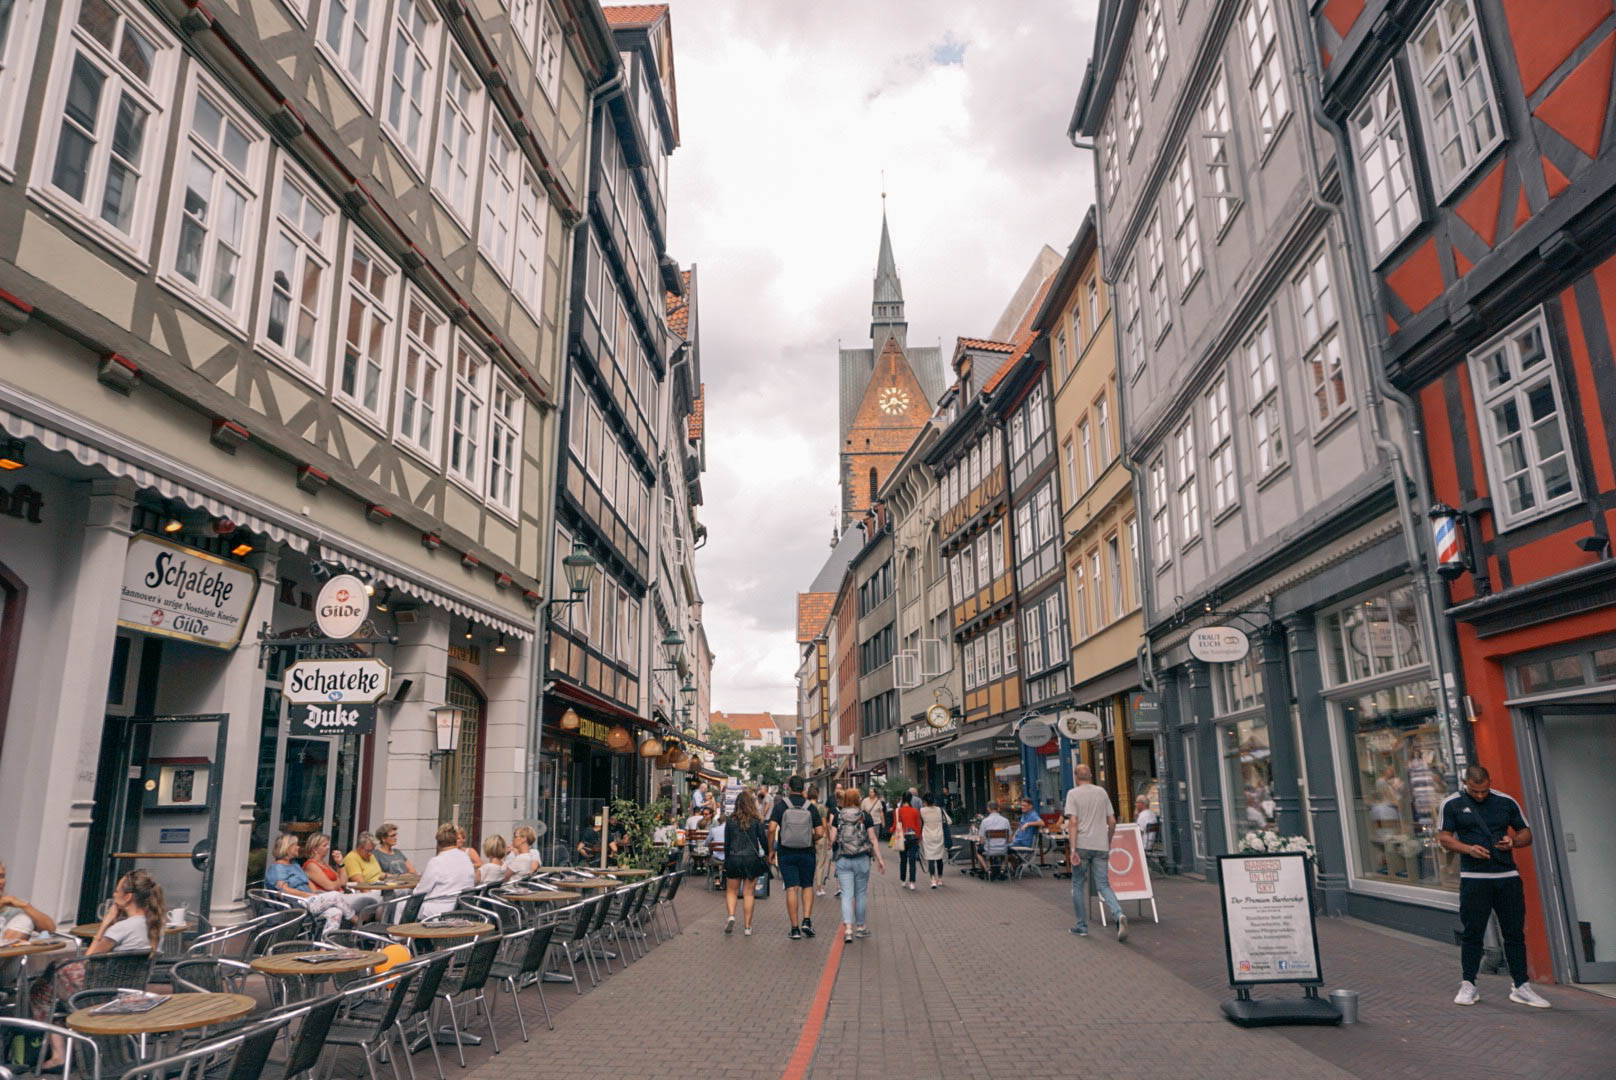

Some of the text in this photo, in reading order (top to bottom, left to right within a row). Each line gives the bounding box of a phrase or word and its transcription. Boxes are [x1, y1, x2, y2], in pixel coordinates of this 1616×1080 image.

[145, 552, 233, 608] Schateke
[163, 599, 182, 610] urige
[185, 602, 216, 618] Nostalgie
[321, 606, 361, 618] Gilde
[173, 615, 208, 636] Gilde
[1198, 633, 1220, 641] TRAUT
[291, 667, 379, 694] Schateke
[303, 704, 360, 729] Duke
